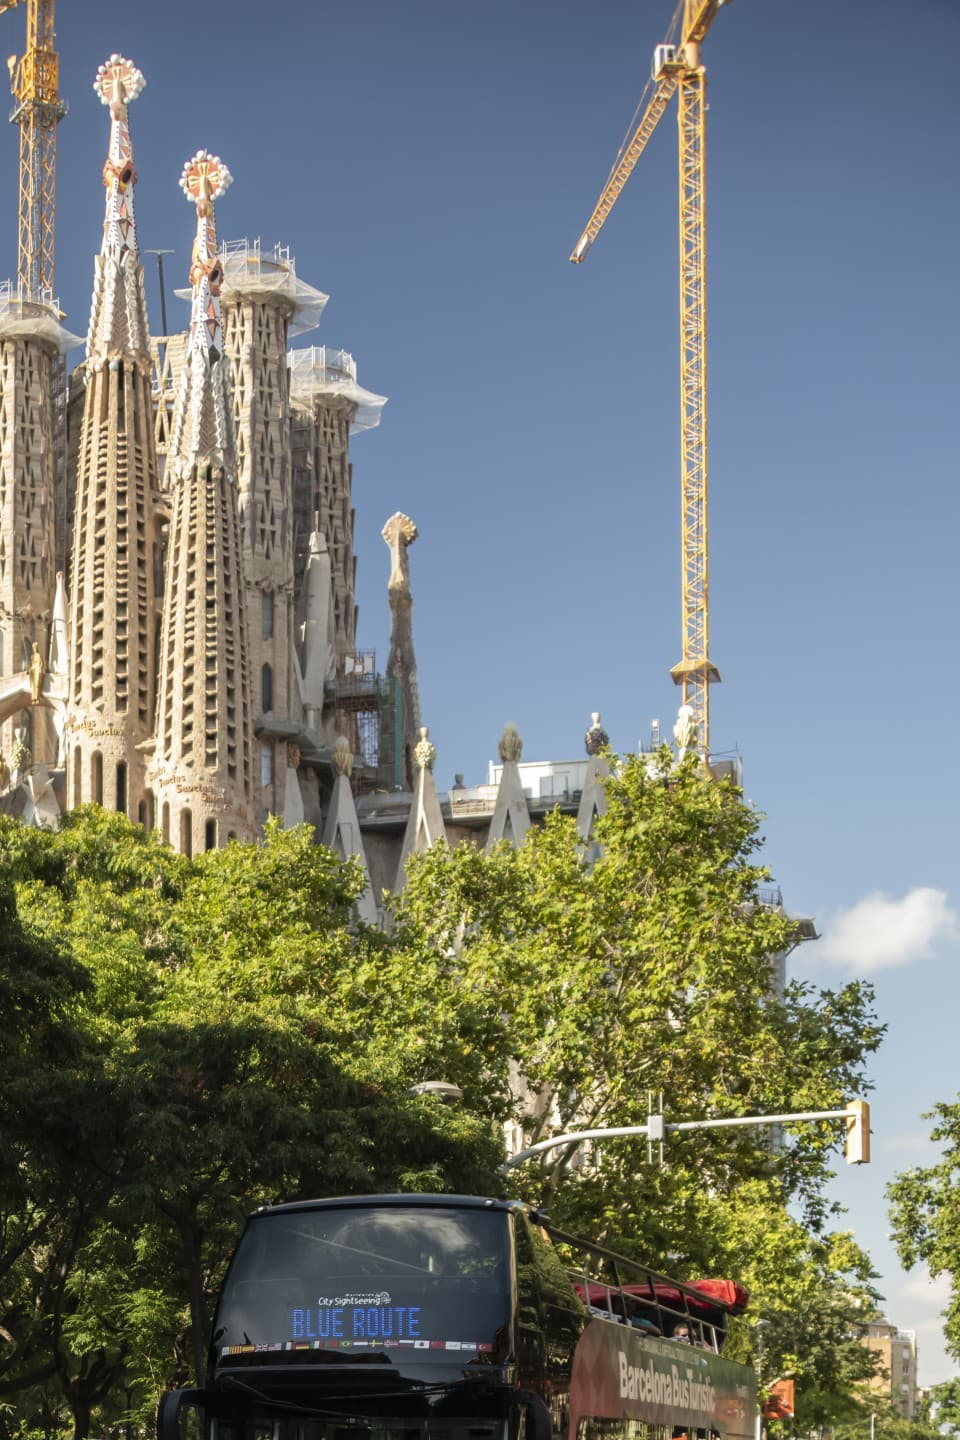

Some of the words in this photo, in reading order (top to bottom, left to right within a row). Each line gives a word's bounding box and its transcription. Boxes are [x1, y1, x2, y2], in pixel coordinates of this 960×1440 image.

[318, 1297, 334, 1306] City
[335, 1297, 381, 1306] Sightseeing
[292, 1308, 344, 1337] BLUE
[352, 1307, 421, 1336] ROUTE
[618, 1351, 672, 1405] Barcelona
